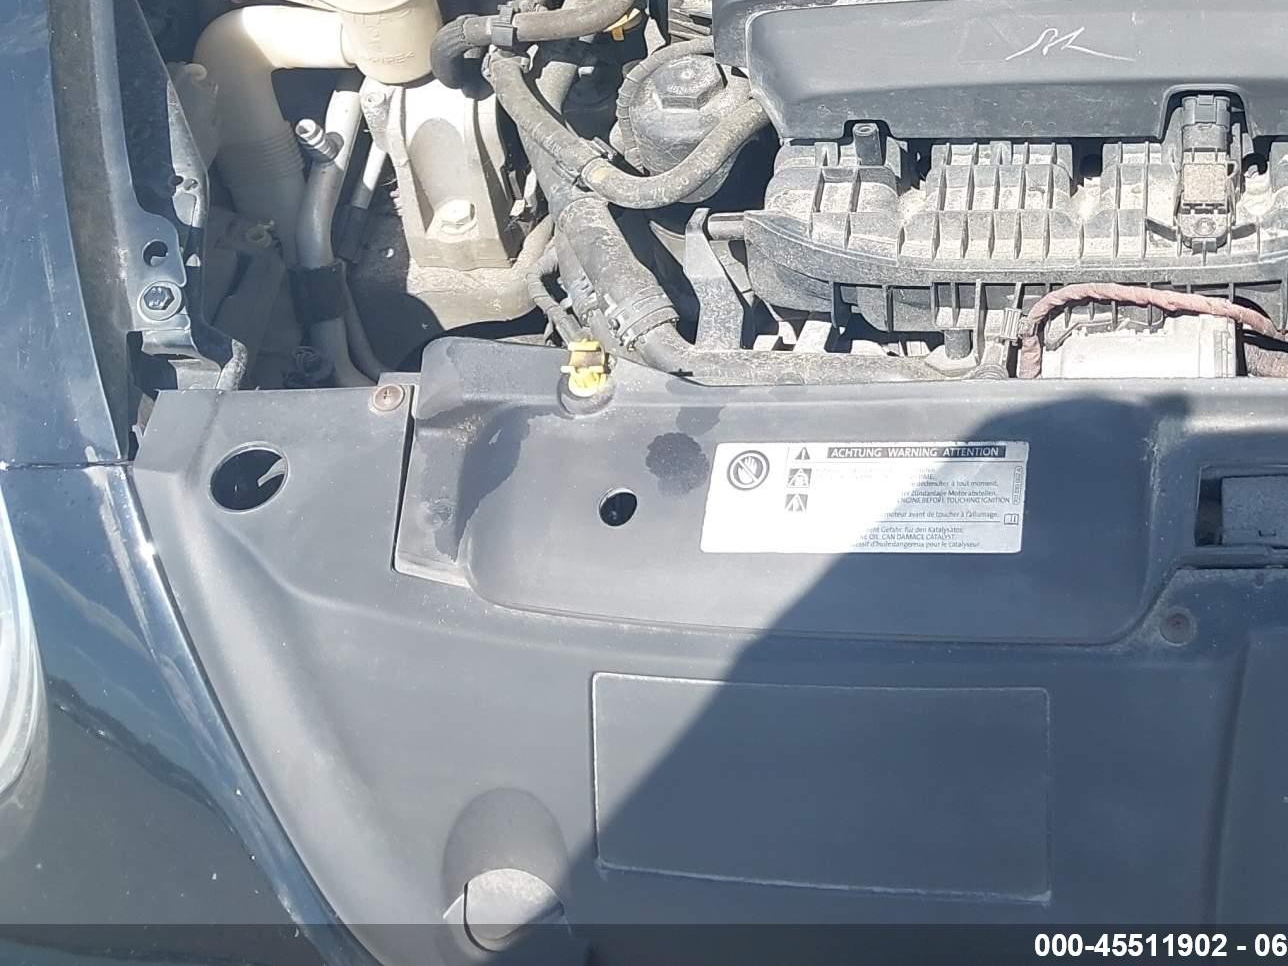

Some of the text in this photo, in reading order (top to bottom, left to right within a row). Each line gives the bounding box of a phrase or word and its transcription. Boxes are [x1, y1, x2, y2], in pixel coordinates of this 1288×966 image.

[831, 446, 999, 458] ACHTUNG WARNING ATTENTION
